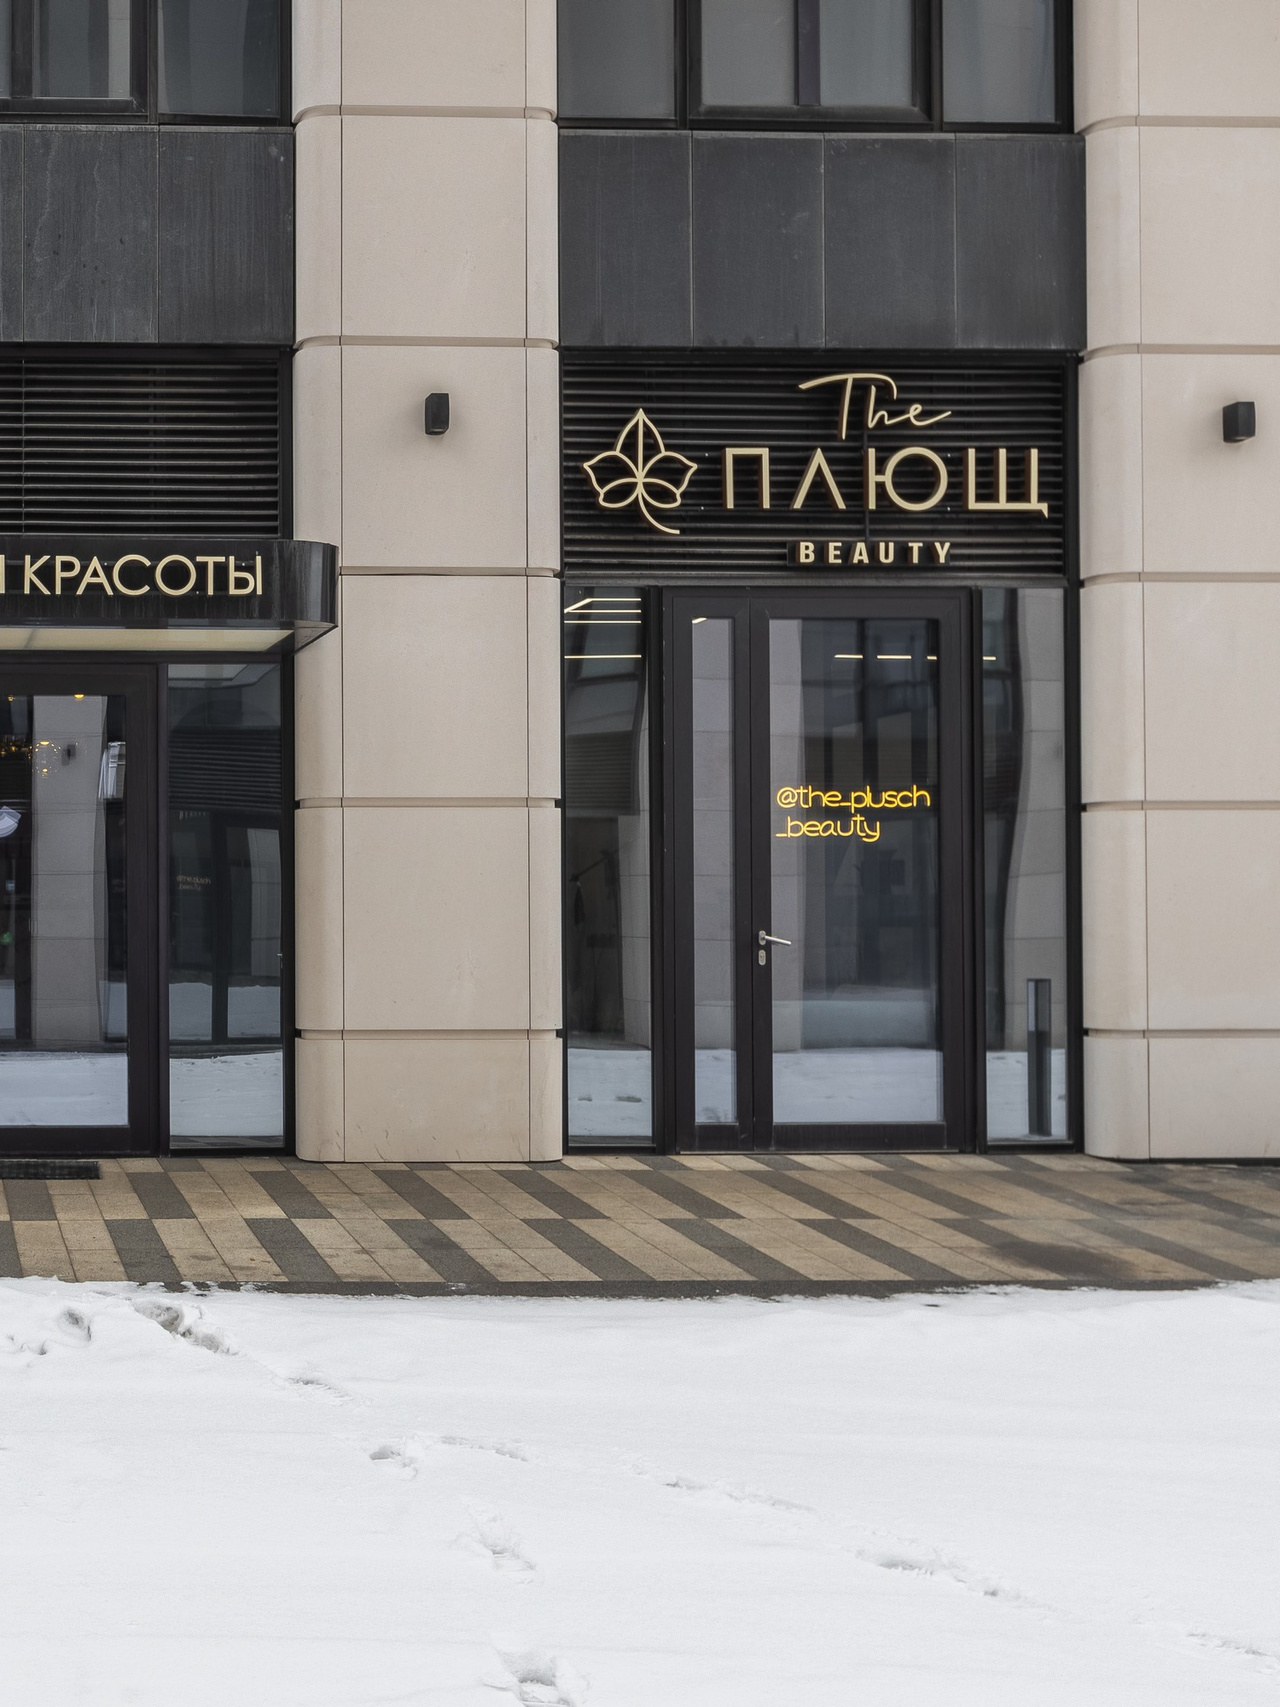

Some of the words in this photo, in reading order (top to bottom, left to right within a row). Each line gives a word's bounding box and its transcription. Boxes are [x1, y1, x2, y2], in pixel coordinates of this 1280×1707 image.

[798, 372, 952, 441] The
[722, 446, 1049, 519] ПЛЮЩ
[23, 553, 263, 596] КРАСОТЫ
[798, 541, 952, 565] BEAUTY
[776, 784, 932, 814] @the_plusch
